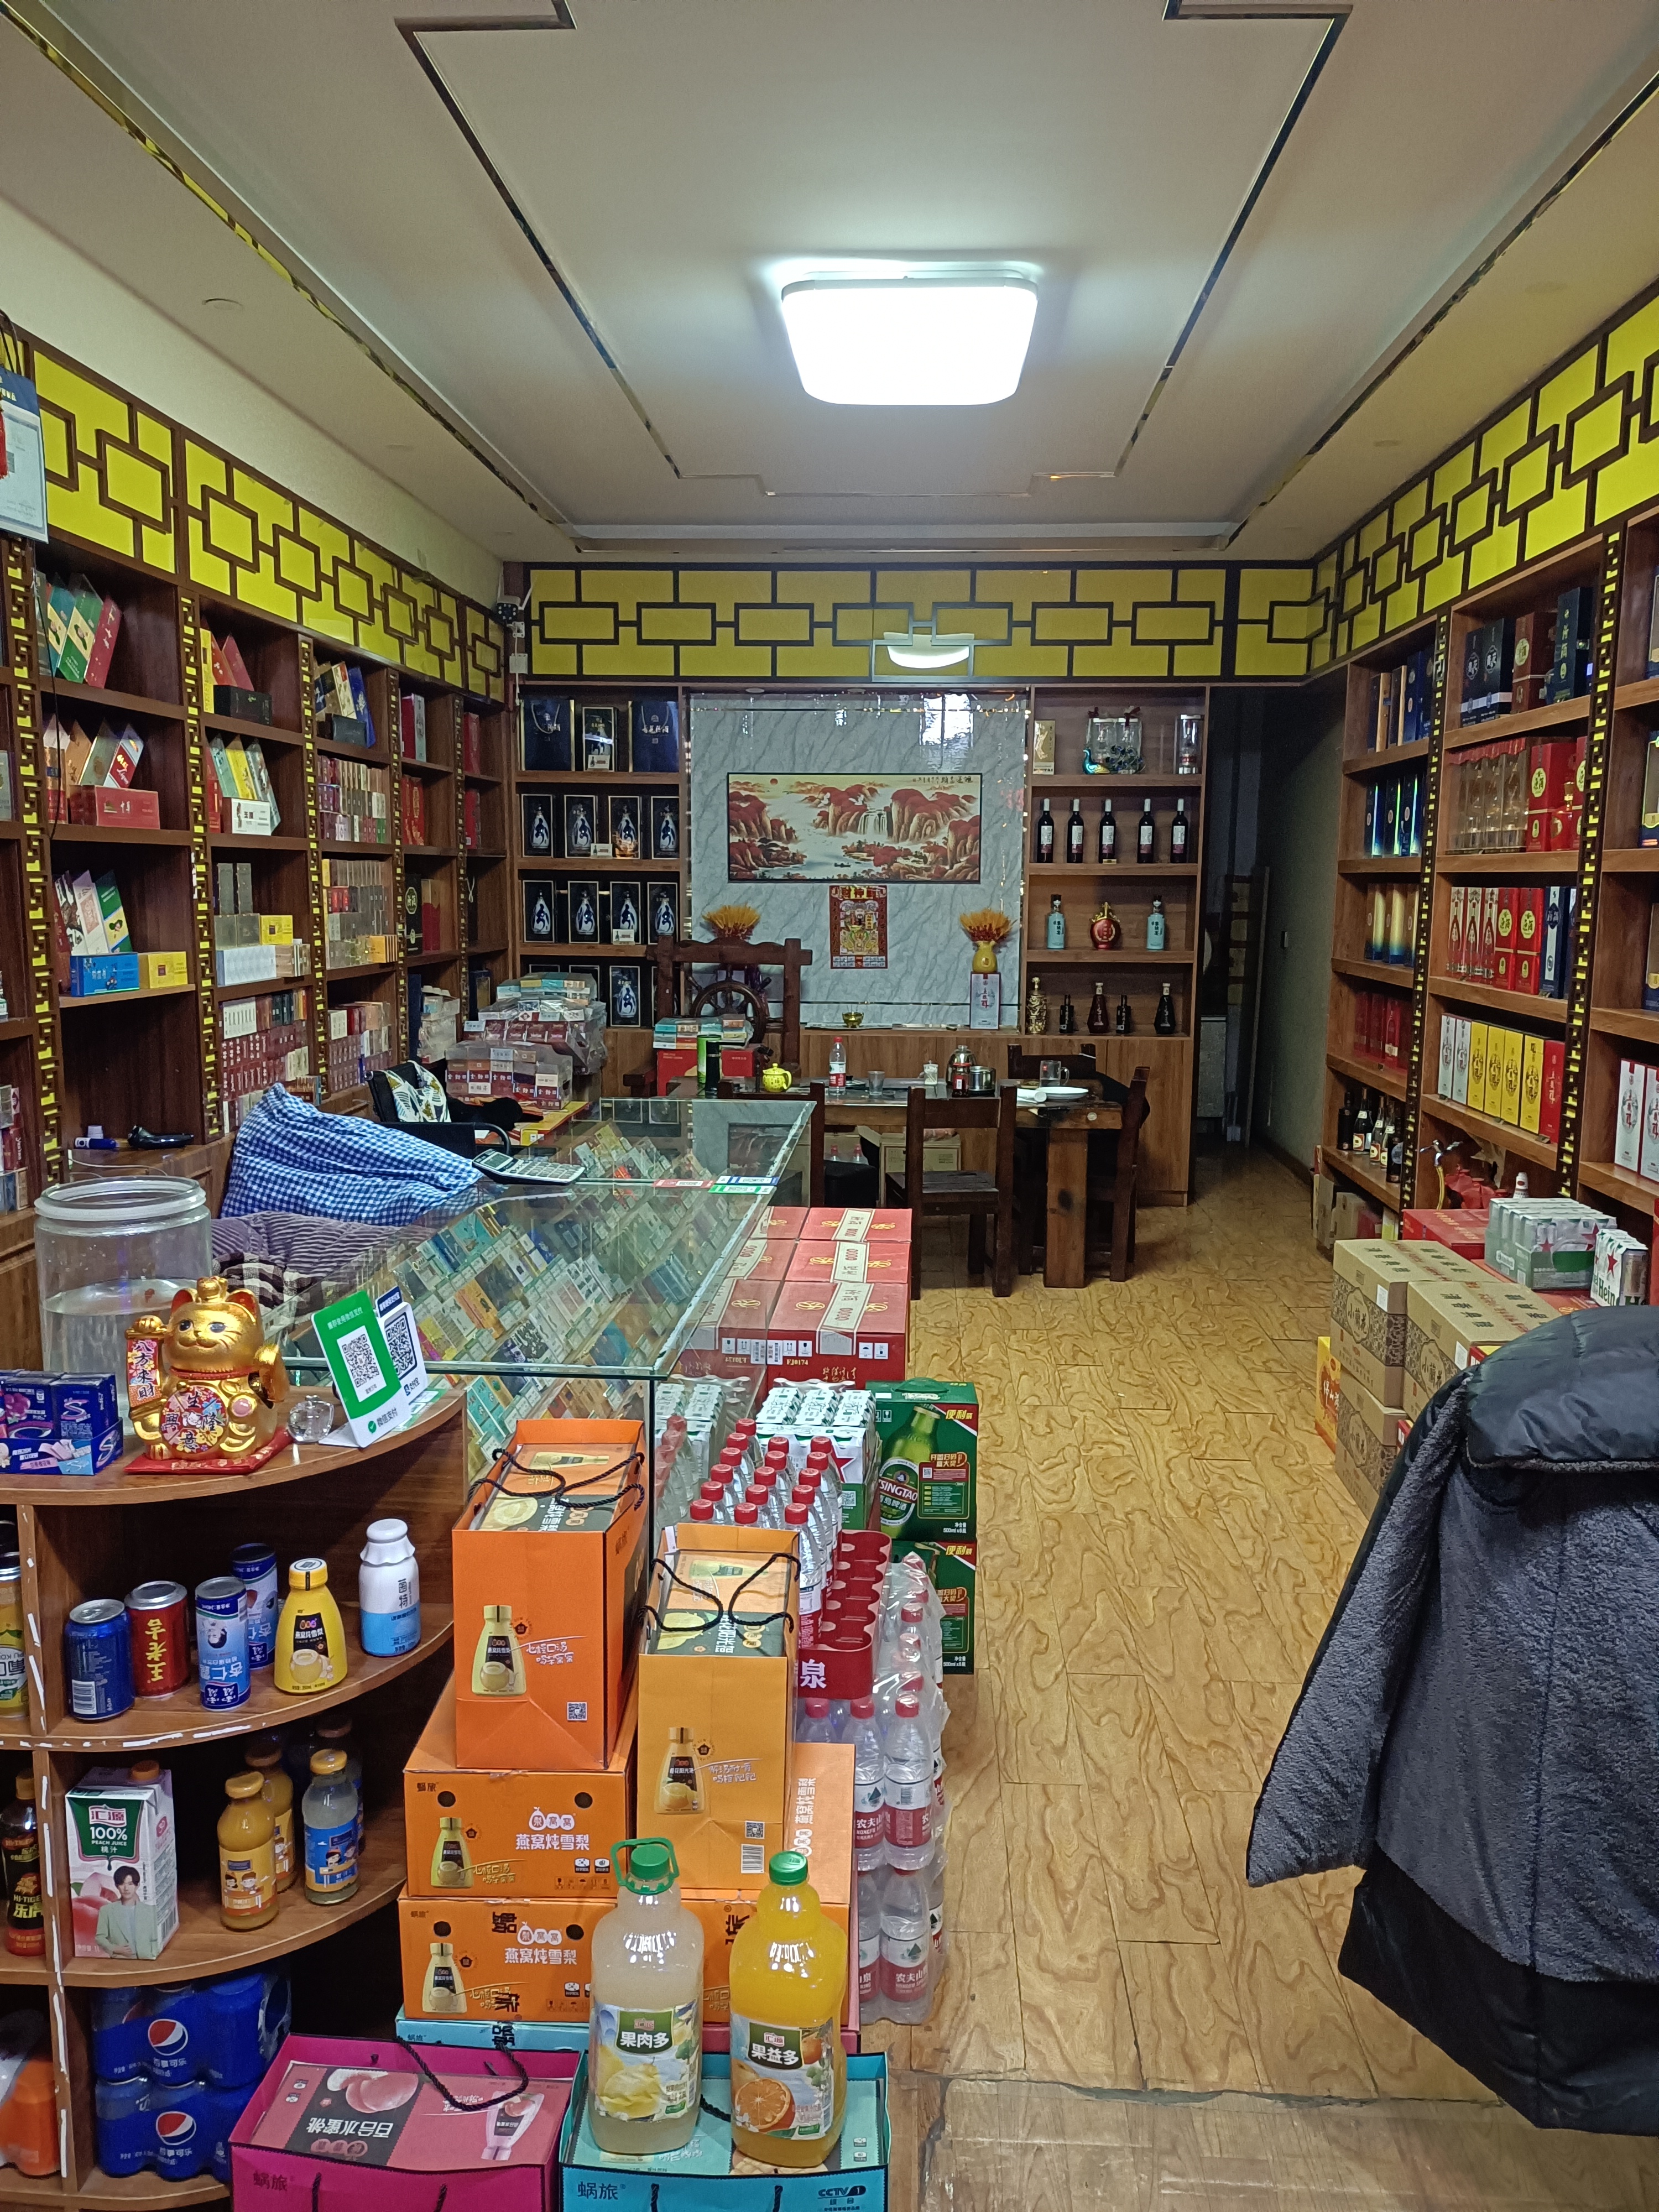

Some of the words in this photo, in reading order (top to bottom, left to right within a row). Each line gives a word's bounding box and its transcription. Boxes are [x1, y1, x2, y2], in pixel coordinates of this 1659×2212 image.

[376, 1408, 399, 1428] 微信支付
[247, 1621, 272, 1640] 杏仁
[145, 1618, 167, 1680] 王老吉
[800, 1658, 827, 1689] 泉
[795, 1777, 817, 1825] 燕窝炖雪梨
[90, 1827, 128, 1840] 100%
[515, 1833, 589, 1851] 燕窝炖雪梨
[13, 1894, 41, 1903] HI-TIGE
[504, 1948, 577, 1965] 燕窝炖雪梨
[620, 2031, 670, 2049] 果肉多
[751, 2043, 799, 2066] 果益多
[306, 2117, 394, 2138] 百合水蜜桃
[577, 2181, 619, 2200] 蜗旅
[818, 2187, 850, 2198] CCTV
